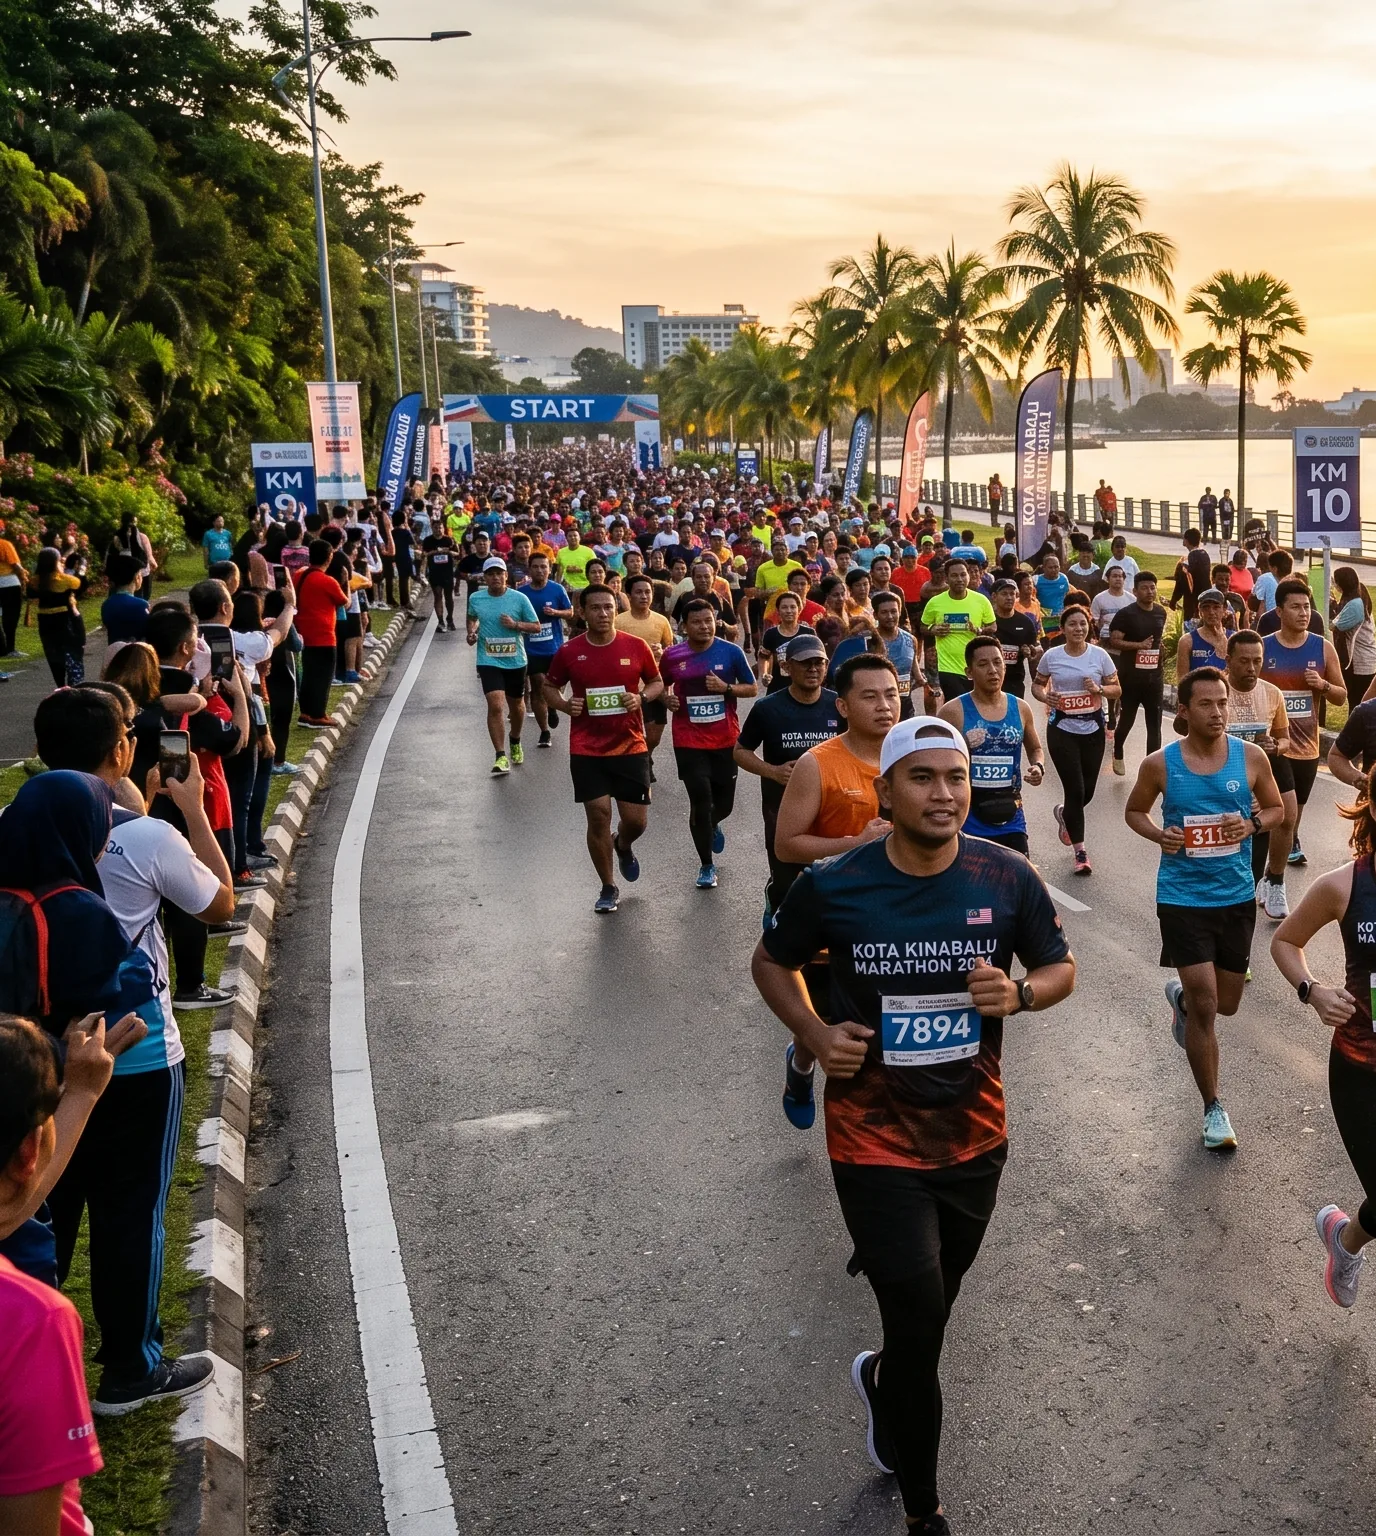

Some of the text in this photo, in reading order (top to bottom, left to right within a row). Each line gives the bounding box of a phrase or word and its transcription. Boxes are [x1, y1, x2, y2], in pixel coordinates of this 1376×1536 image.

[510, 399, 595, 419] START
[265, 471, 303, 490] KM
[1311, 462, 1347, 482] KM
[1307, 487, 1351, 523] 10
[781, 732, 803, 740] KOTA
[975, 766, 1008, 778] 1322
[852, 938, 997, 959] KOTA KINABALU
[854, 958, 952, 975] MARATHON
[891, 1012, 972, 1045] 7894
